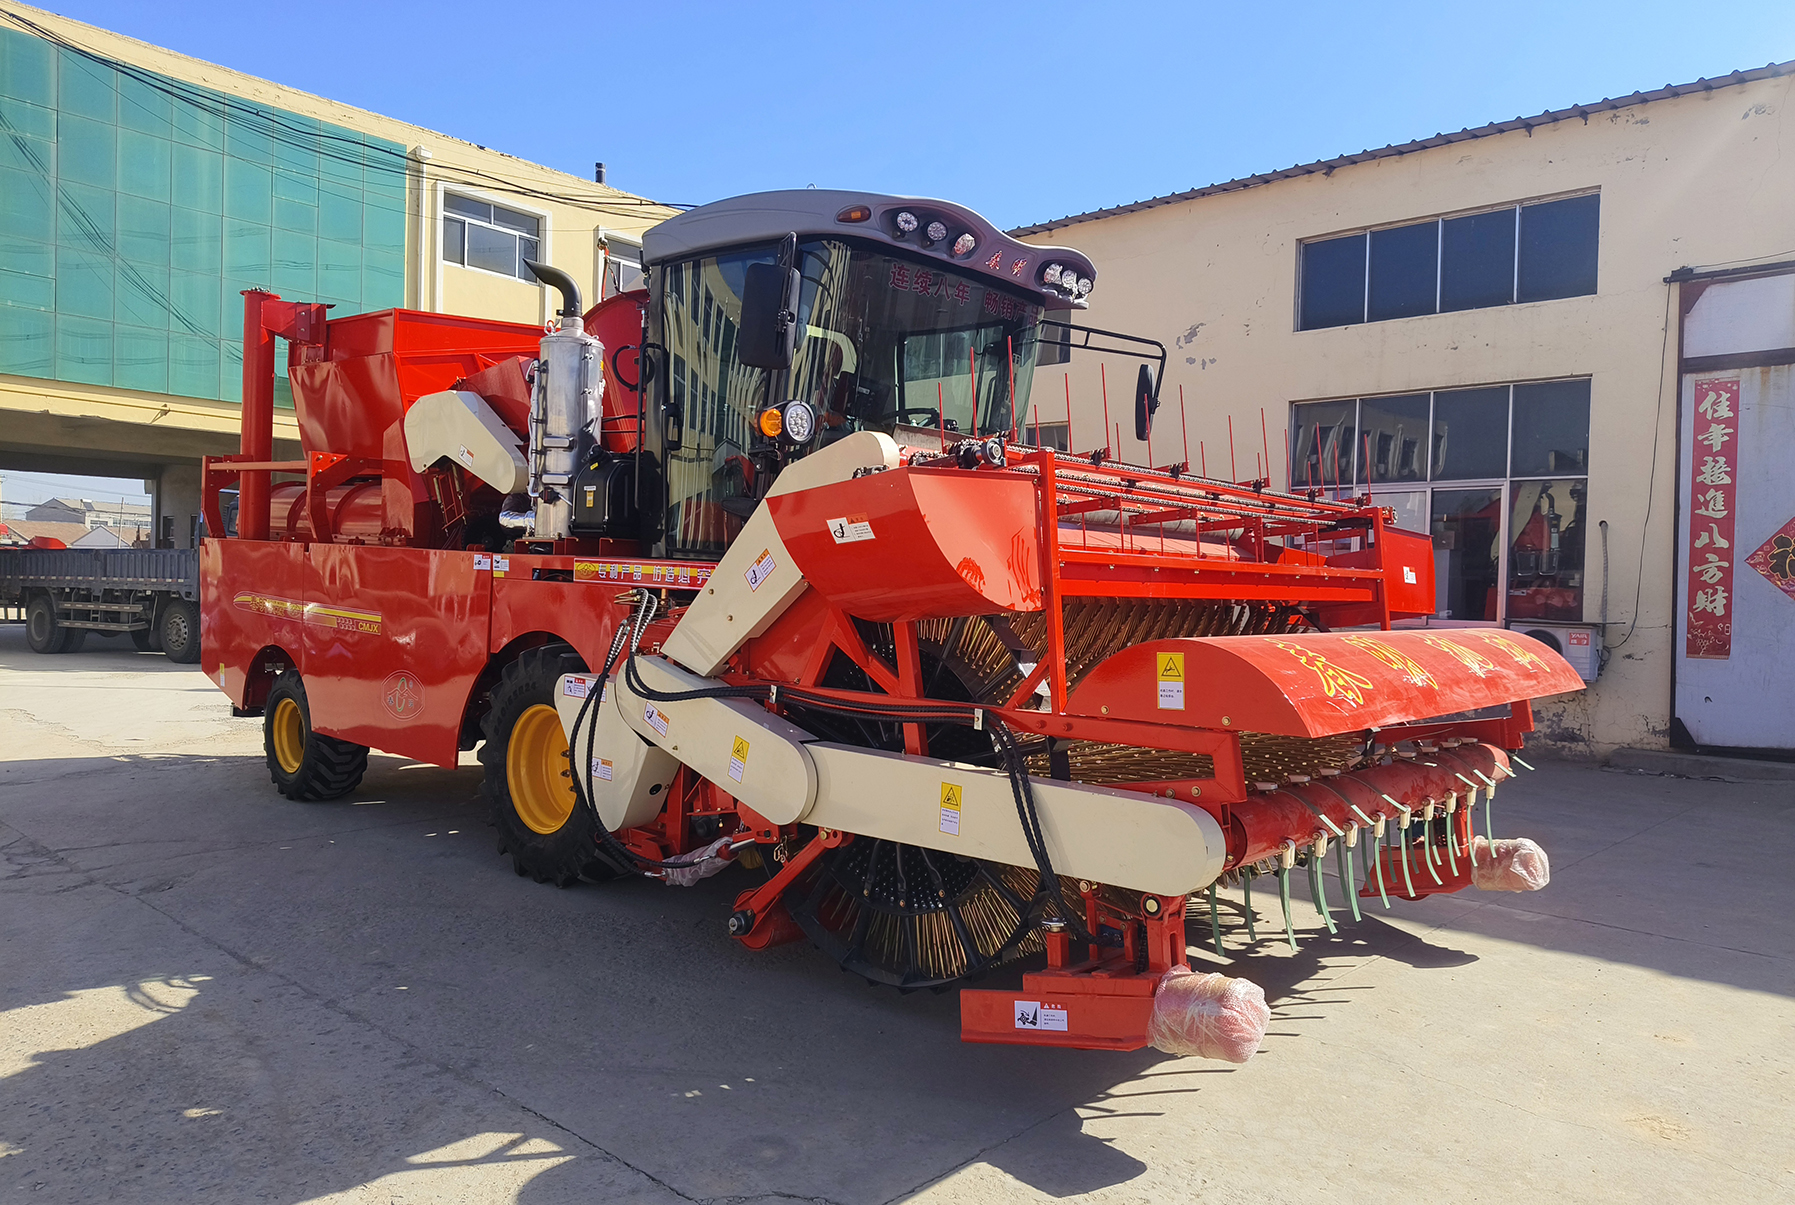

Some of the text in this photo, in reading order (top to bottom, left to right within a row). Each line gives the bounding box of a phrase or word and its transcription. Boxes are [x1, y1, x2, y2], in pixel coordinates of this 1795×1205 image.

[889, 263, 1039, 327] 连续八年 畅销产品
[598, 562, 643, 581] 专利产品
[358, 622, 379, 633] CMJX
